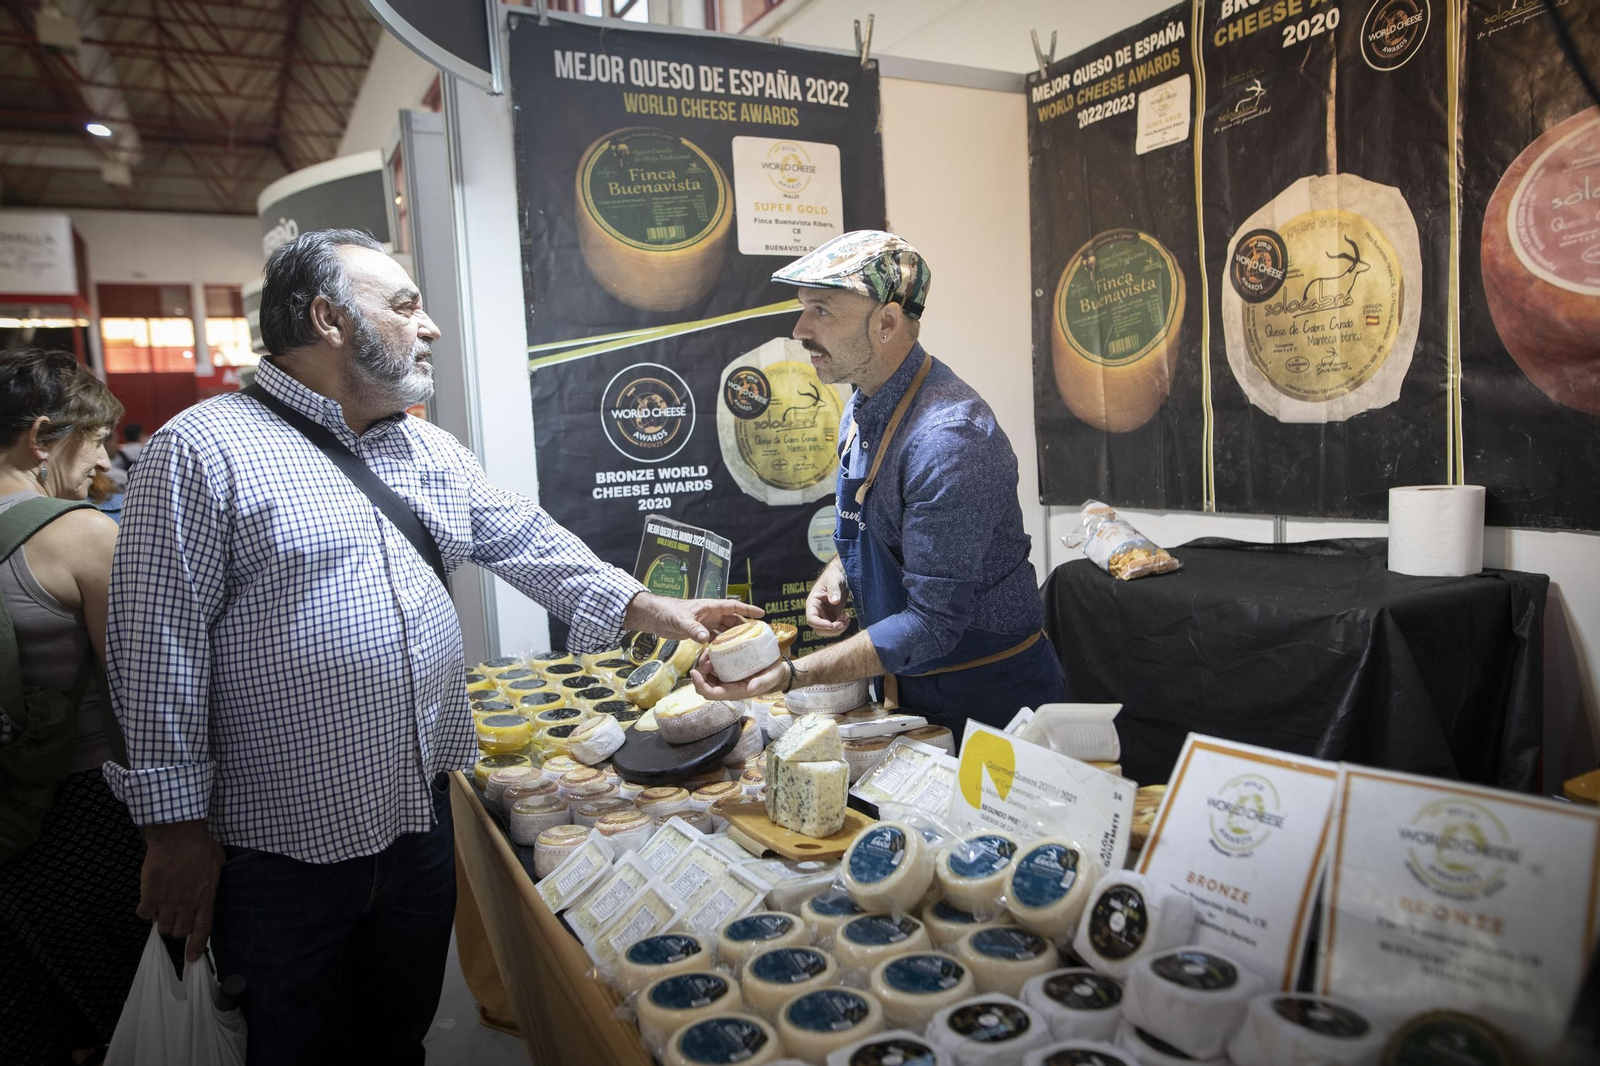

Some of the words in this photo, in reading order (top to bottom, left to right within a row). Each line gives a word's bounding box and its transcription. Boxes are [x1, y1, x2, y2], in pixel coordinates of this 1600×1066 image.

[1214, 0, 1302, 47] CHEESE
[1282, 8, 1340, 48] 2020
[1368, 22, 1396, 42] WORLD
[1395, 12, 1423, 30] CHEESE
[1382, 38, 1408, 53] AWARDS
[1032, 77, 1070, 103] MEJOR
[1073, 54, 1114, 86] QUESO
[1115, 45, 1132, 68] DE
[1134, 20, 1186, 59] ESPAÑA
[554, 50, 625, 84] MEJOR
[630, 58, 694, 91] QUESO
[699, 65, 724, 94] DE
[730, 67, 802, 101] ESPAÑA
[806, 78, 849, 108] 2022
[1038, 96, 1074, 122] WORLD
[1076, 78, 1125, 105] CHEESE
[1128, 48, 1180, 81] AWARDS
[624, 92, 678, 116] WORLD
[681, 96, 737, 122] CHEESE
[740, 102, 800, 126] AWARDS
[1077, 92, 1136, 129] 2022/2023
[628, 168, 678, 182] Finca
[762, 162, 790, 172] WORLD
[792, 164, 816, 174] CHEESE
[608, 178, 702, 196] Buenavista
[754, 202, 792, 212] SUPER
[797, 204, 828, 215] GOLD
[775, 218, 812, 226] Buenavista
[813, 220, 835, 228] Ribera,
[1236, 253, 1258, 270] WORLD
[1258, 263, 1284, 280] CHEESE
[1096, 272, 1133, 294] Finca
[1242, 276, 1263, 291] AWARDS
[1080, 278, 1156, 313] Buenavista
[1265, 286, 1354, 317] solocabra
[1265, 323, 1286, 338] Queso
[1289, 318, 1299, 336] de
[1302, 320, 1325, 334] Cabra
[1330, 316, 1354, 330] Curado
[1308, 334, 1336, 346] Manteca
[728, 380, 748, 396] WORLD
[748, 392, 769, 406] CHEESE
[611, 407, 650, 419] WORLD
[652, 406, 686, 418] CHEESE
[734, 398, 752, 411] AWARDS
[633, 429, 668, 442] AWARDS
[596, 468, 655, 485] BRONZE
[658, 465, 708, 482] WORLD
[592, 484, 650, 500] CHEESE
[653, 478, 714, 496] AWARDS
[638, 497, 672, 511] 2020
[647, 523, 660, 535] MEJOR
[692, 536, 706, 546] 2022
[653, 580, 680, 590] Buenavista
[782, 582, 805, 595] FINCA
[765, 601, 790, 614] CALLE
[1006, 797, 1027, 811] Quesos
[1060, 791, 1077, 803] 2021
[980, 813, 998, 826] QUESOS
[981, 802, 1006, 820] SEGUNDO
[1206, 796, 1245, 817] WORLD
[1246, 809, 1286, 829] CHEESE
[1186, 870, 1252, 906] BRONZE
